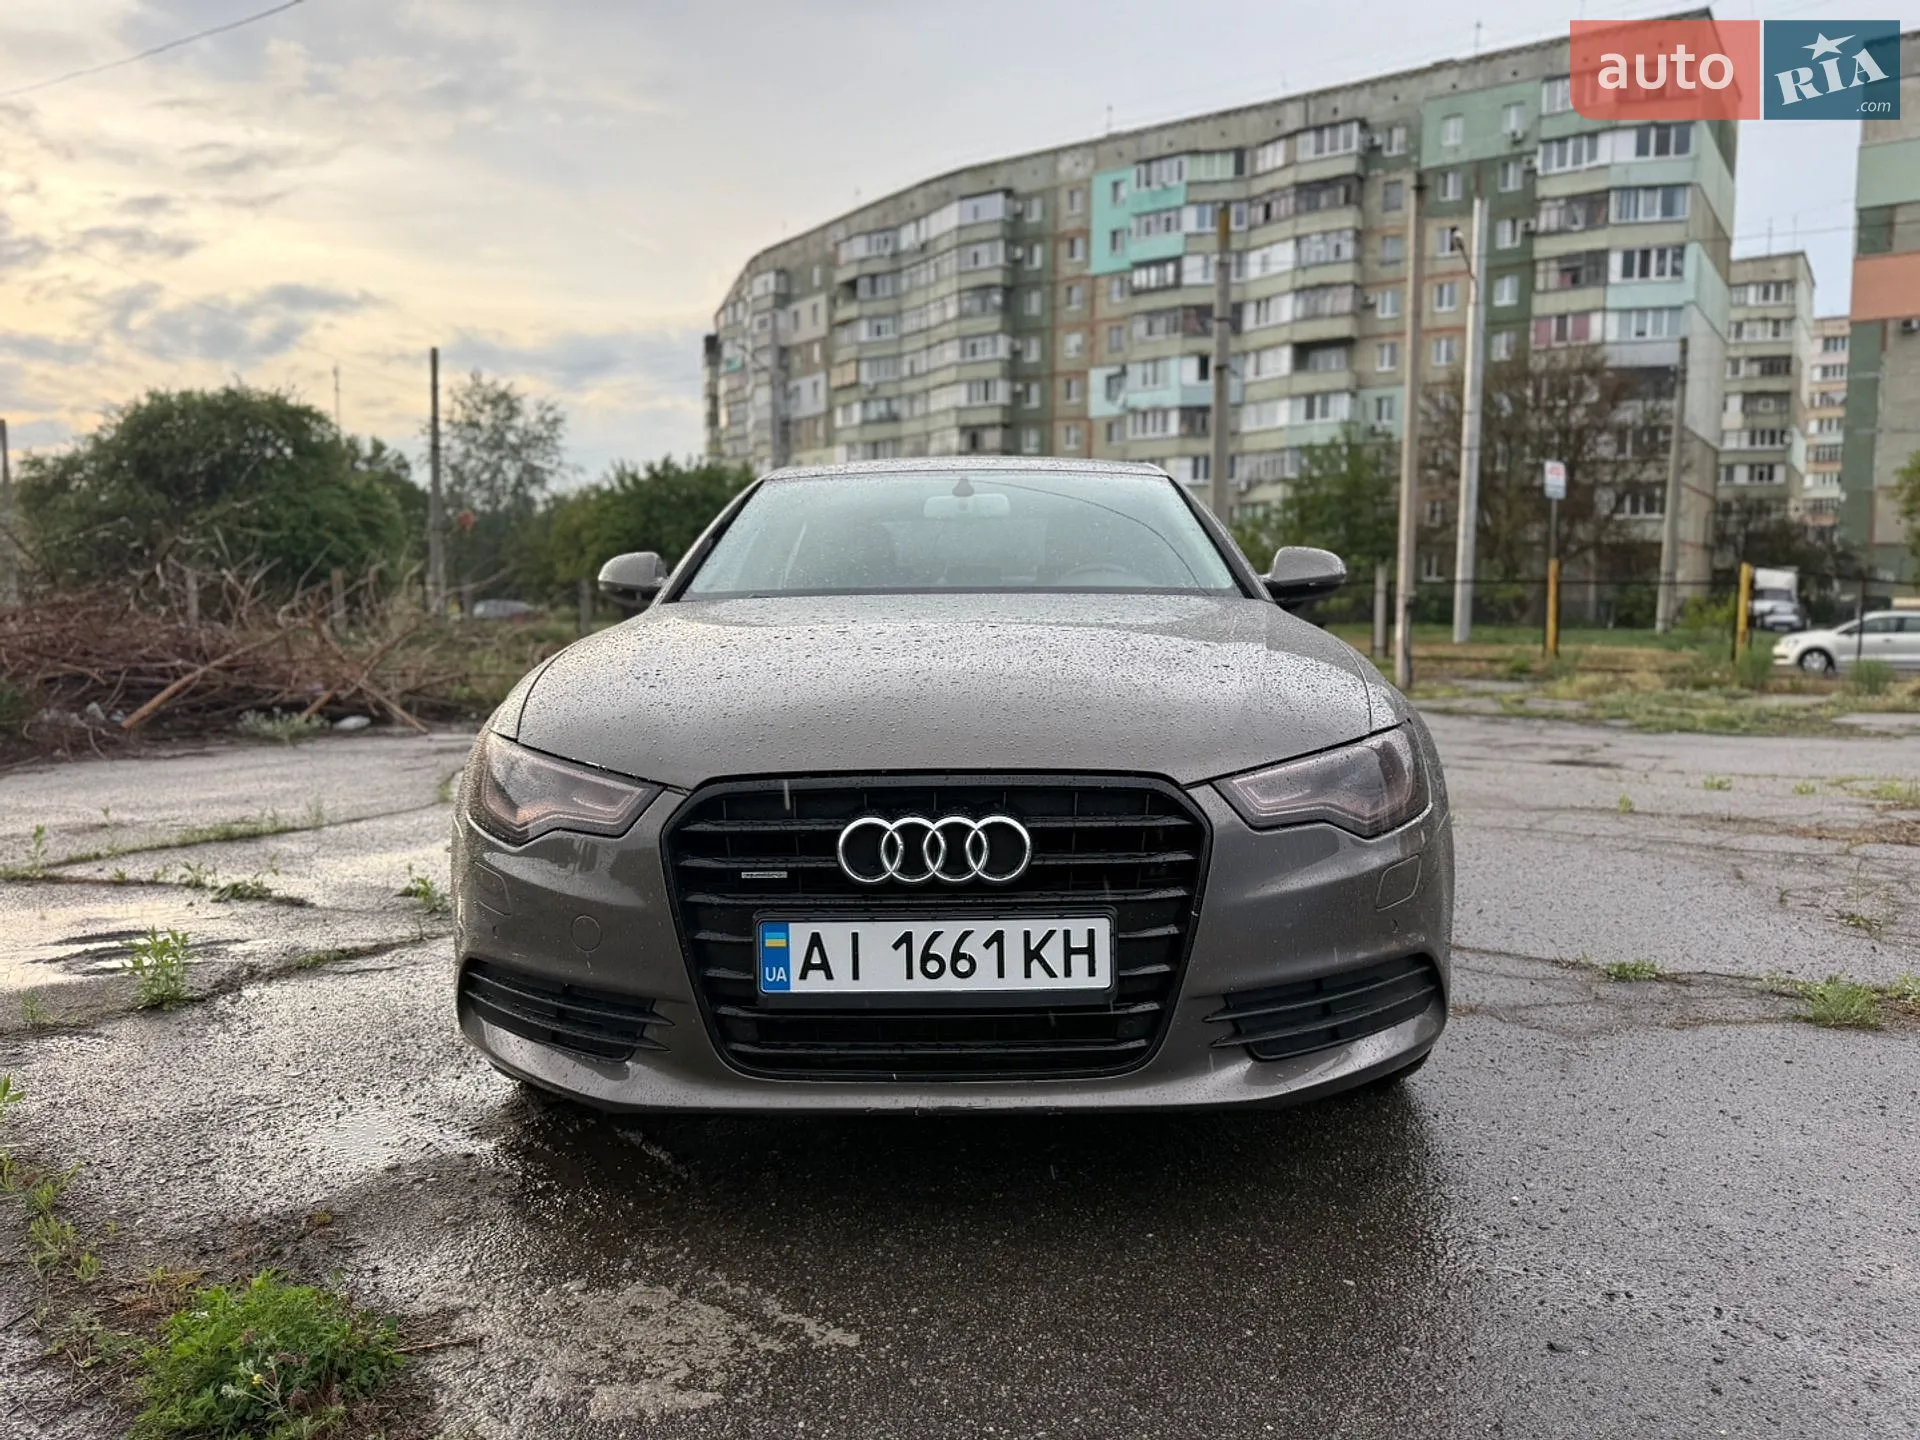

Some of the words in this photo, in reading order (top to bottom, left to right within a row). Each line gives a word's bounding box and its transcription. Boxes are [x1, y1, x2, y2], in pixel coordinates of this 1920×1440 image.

[799, 931, 860, 981] AI
[891, 929, 1005, 980] 1661
[1023, 928, 1097, 979] KH
[765, 966, 787, 983] UA
